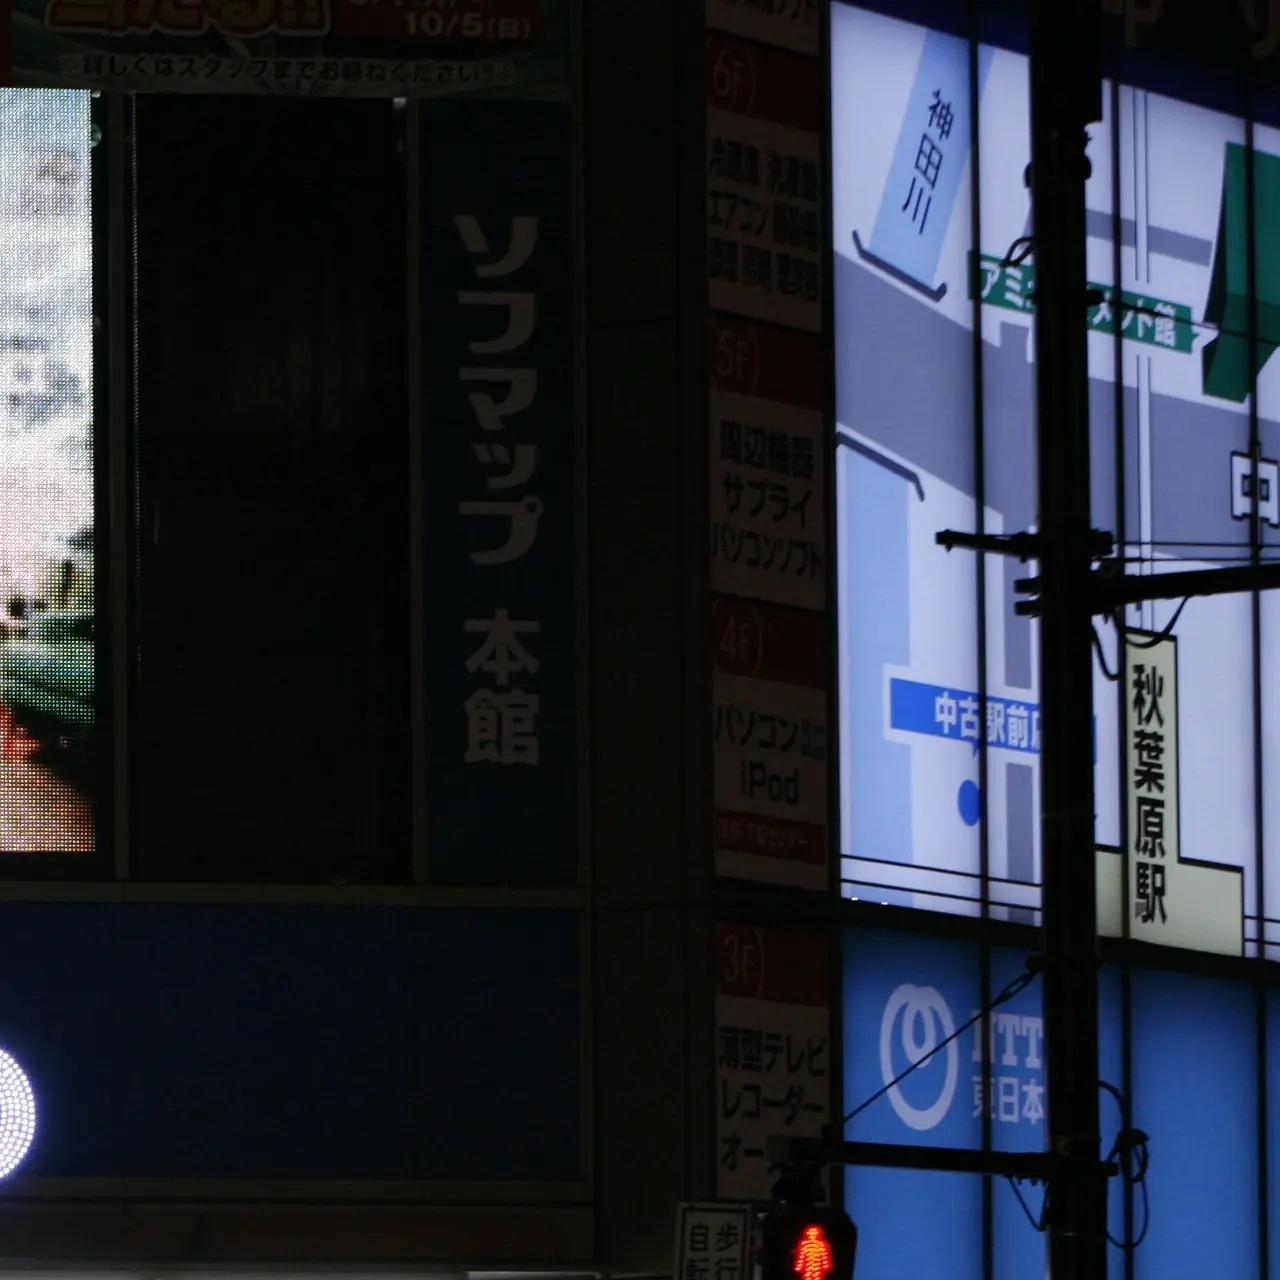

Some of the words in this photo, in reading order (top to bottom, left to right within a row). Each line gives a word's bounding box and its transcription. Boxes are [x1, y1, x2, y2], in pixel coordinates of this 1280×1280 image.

[903, 89, 954, 235] 神田川
[452, 213, 544, 566] ソフマップ
[463, 607, 541, 766] 本館
[713, 702, 799, 754] パソコン
[740, 759, 799, 804] iPod
[1132, 664, 1167, 925] 秋葉原駅
[721, 934, 756, 984] 3F
